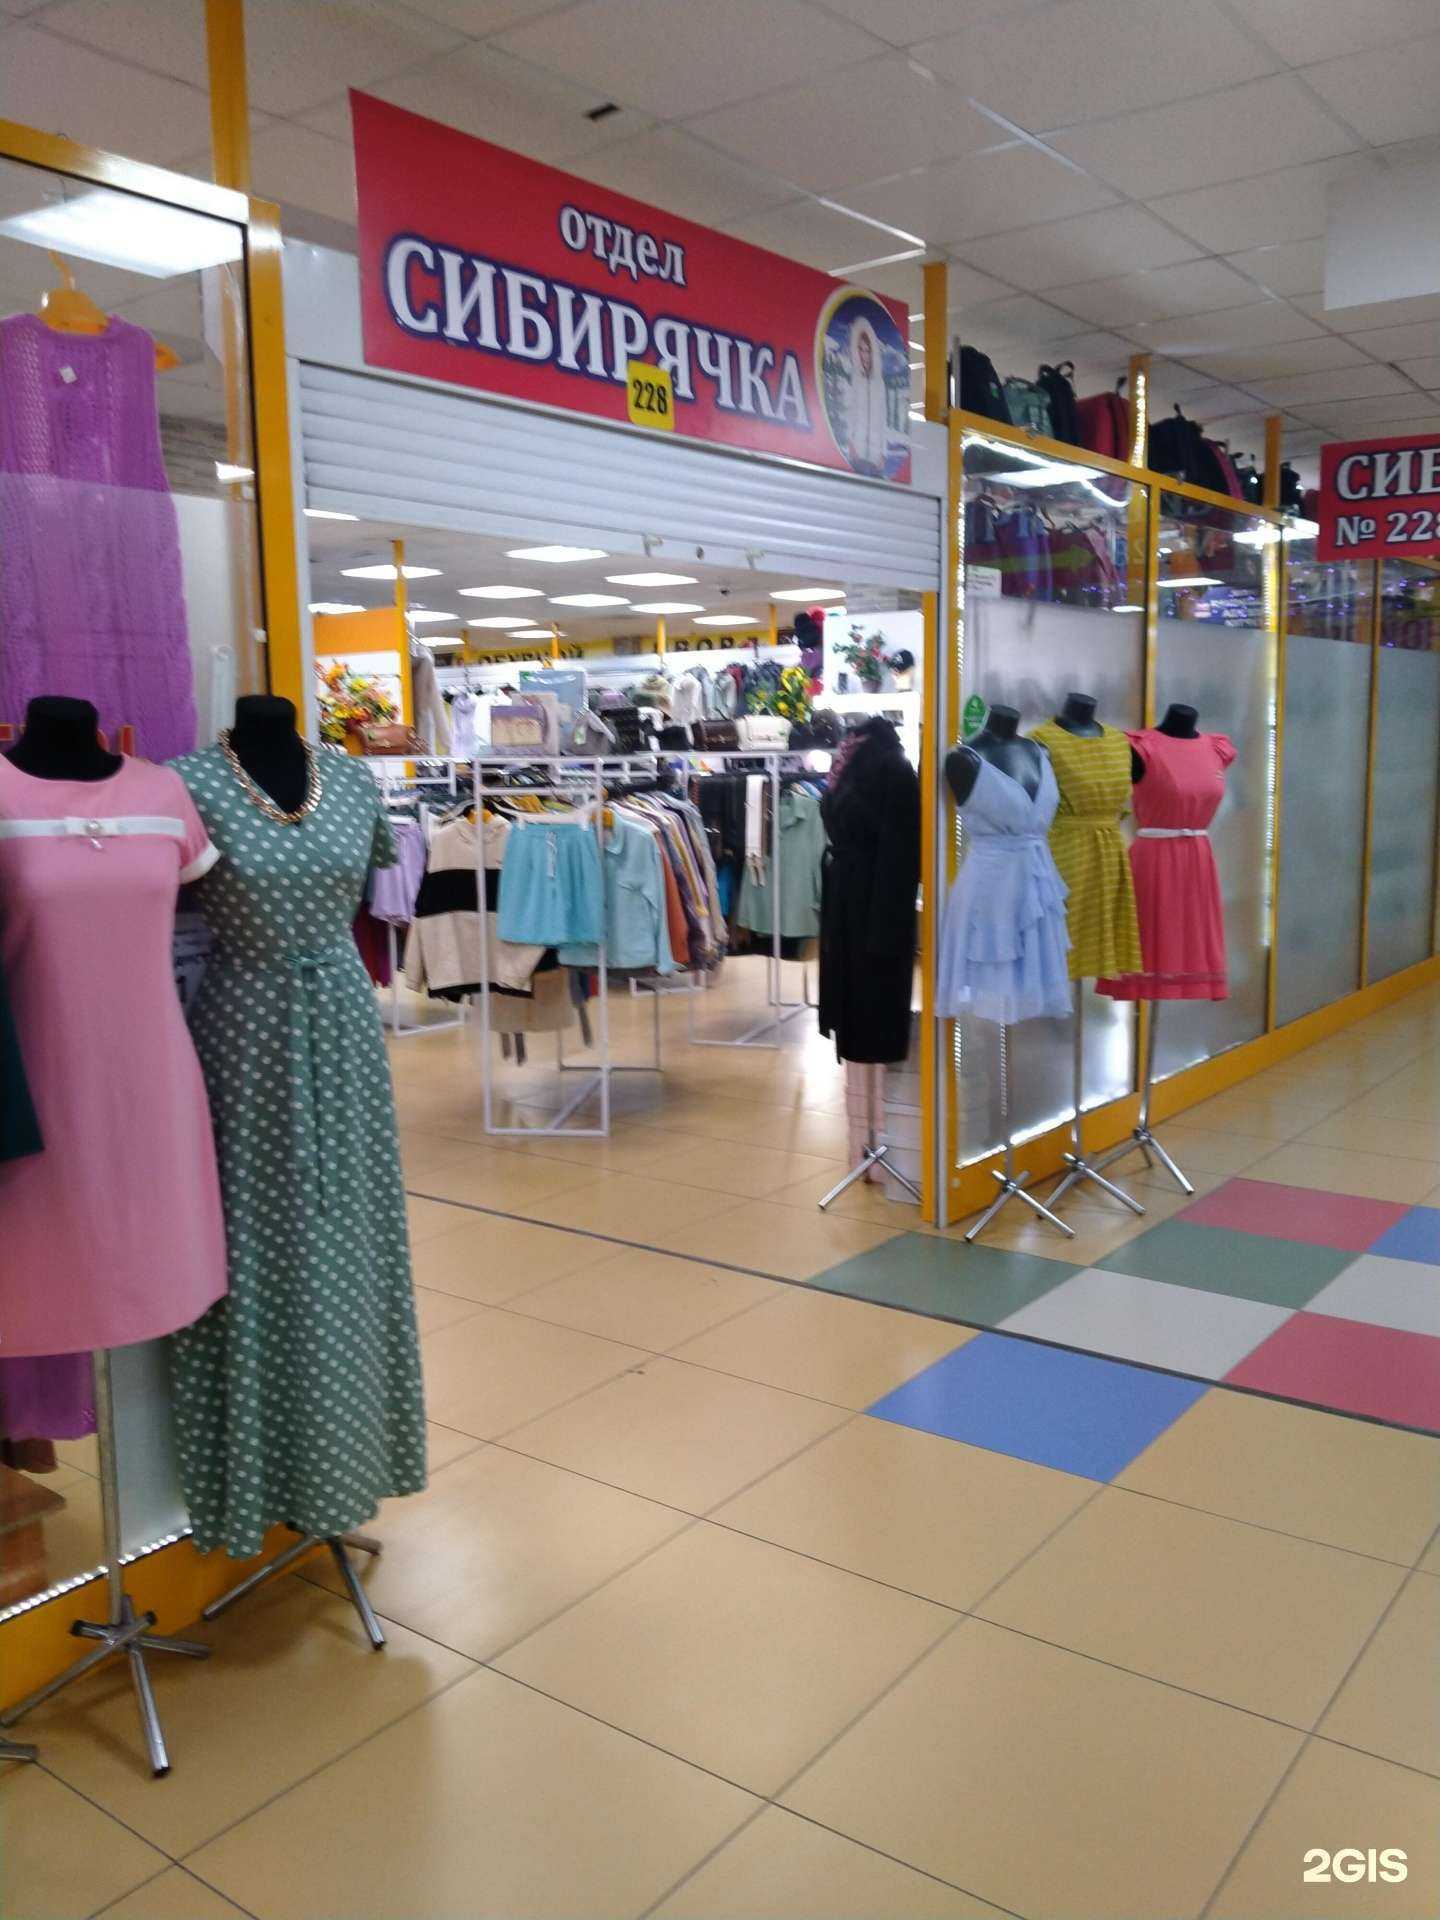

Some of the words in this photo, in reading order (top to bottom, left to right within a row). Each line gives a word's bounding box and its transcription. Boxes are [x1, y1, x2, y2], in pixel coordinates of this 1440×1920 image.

[559, 205, 687, 287] отдел
[386, 236, 811, 427] СИБИРЯЧКА
[632, 379, 668, 415] 228
